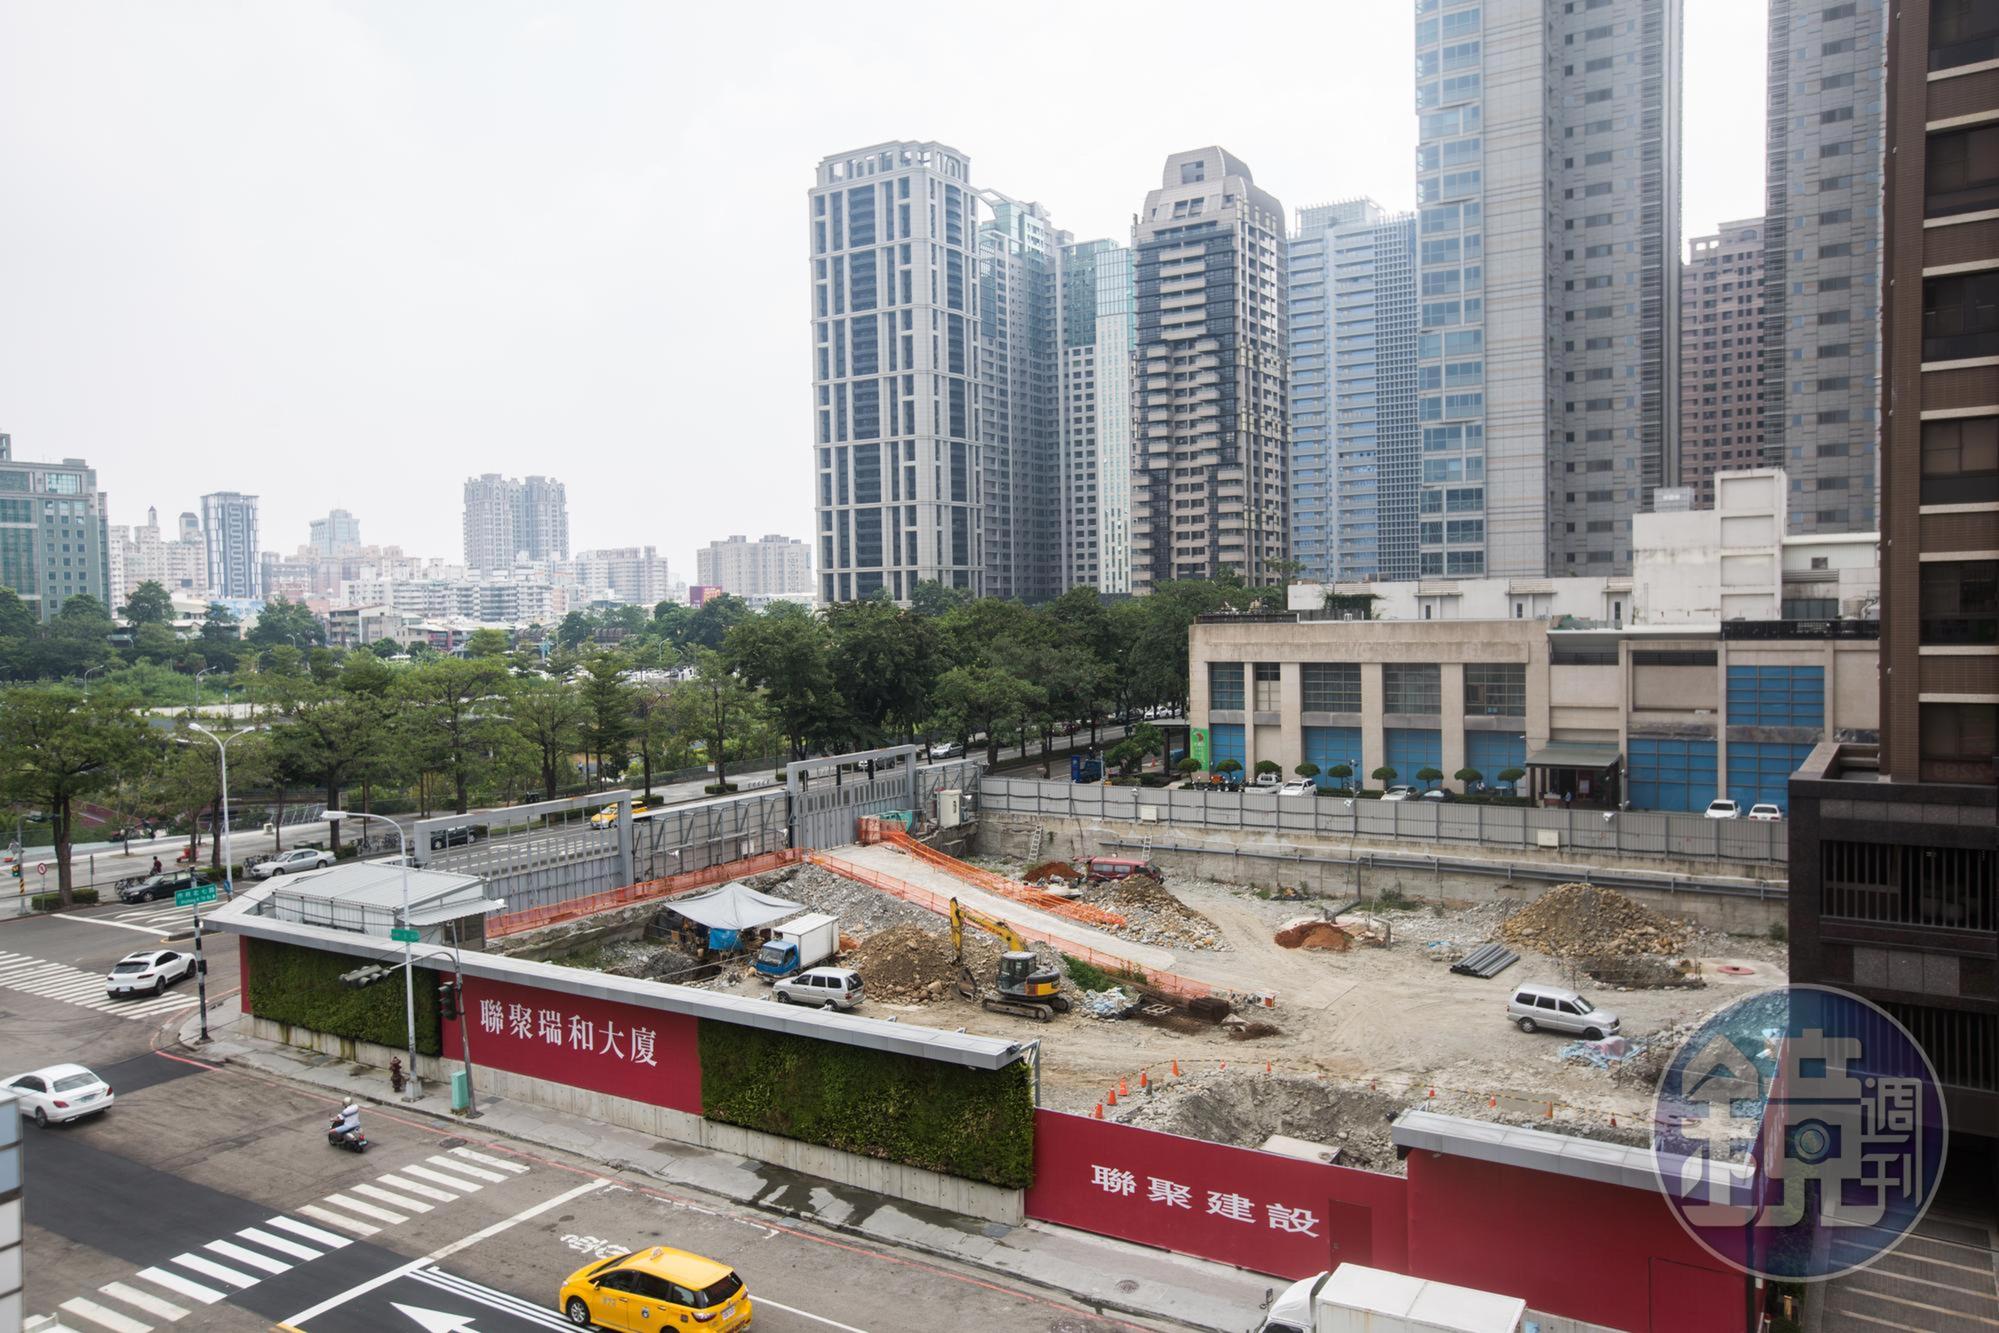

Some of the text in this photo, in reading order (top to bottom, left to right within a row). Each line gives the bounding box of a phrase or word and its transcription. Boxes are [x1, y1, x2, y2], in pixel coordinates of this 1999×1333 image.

[480, 999, 658, 1067] 聯聚瑞和大廈
[1091, 1164, 1320, 1238] 聯聚建設
